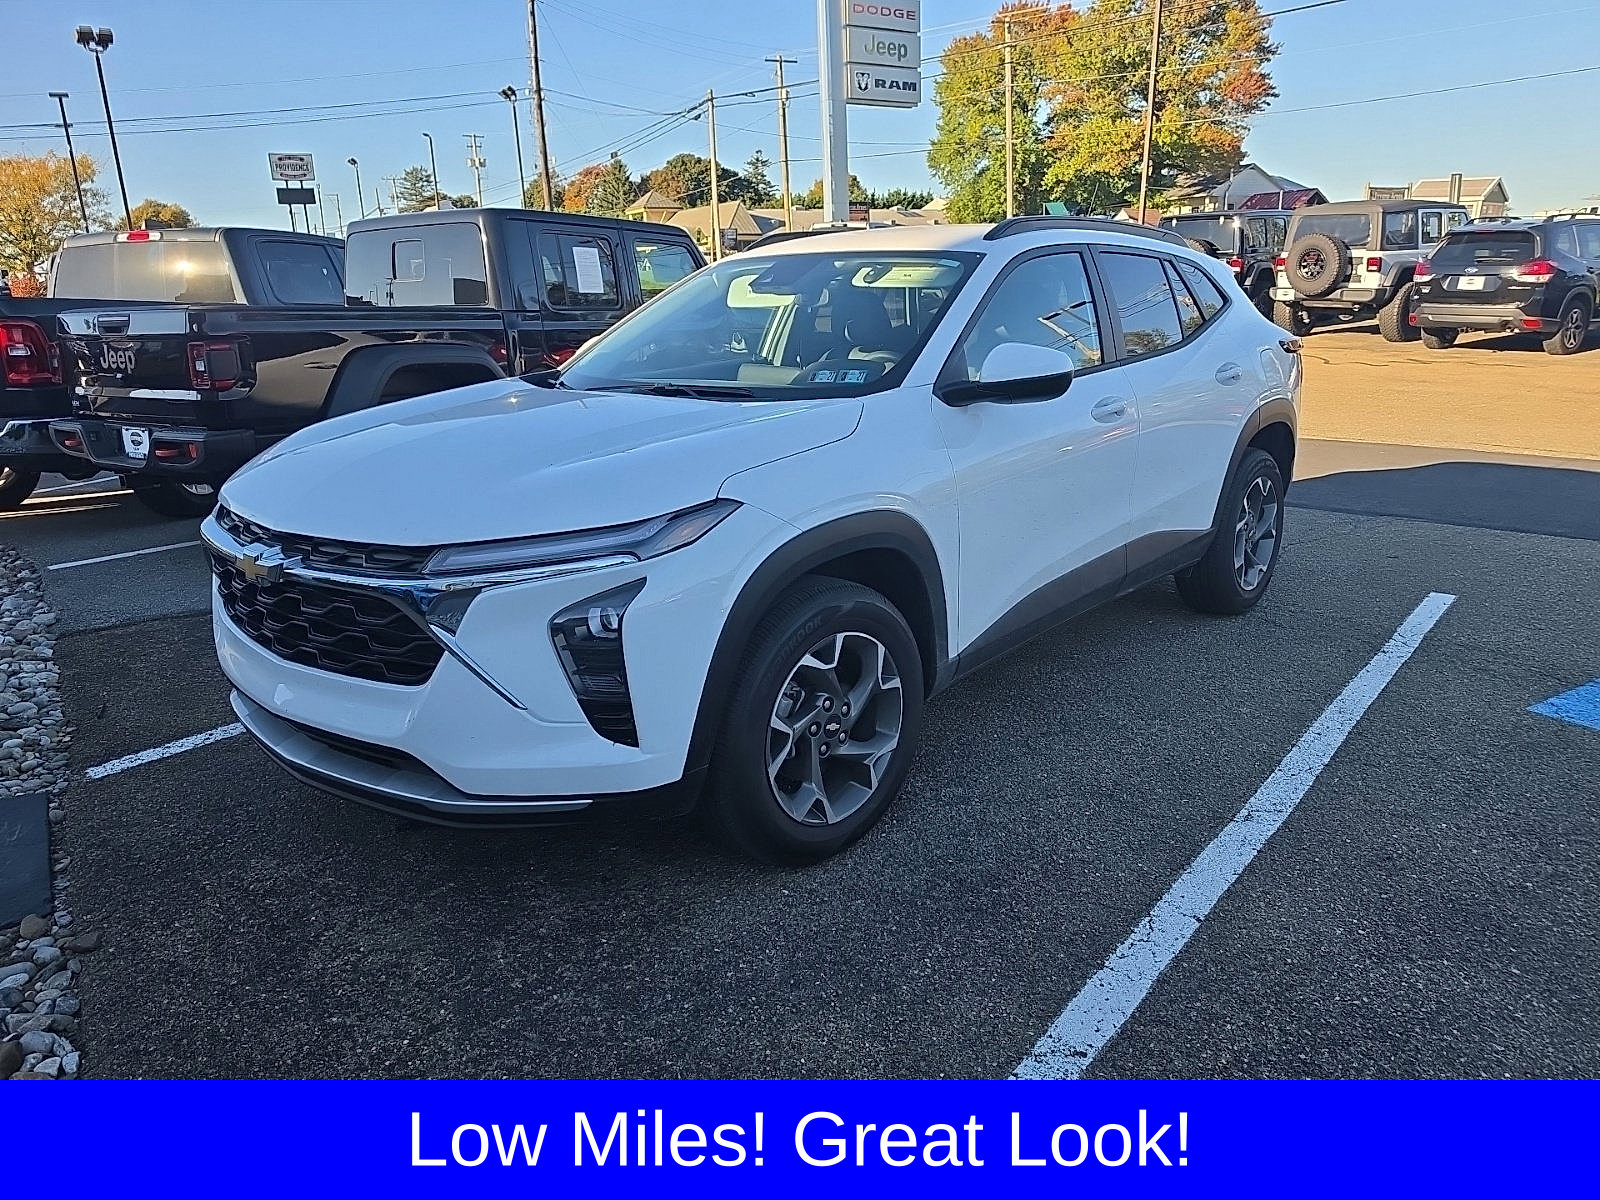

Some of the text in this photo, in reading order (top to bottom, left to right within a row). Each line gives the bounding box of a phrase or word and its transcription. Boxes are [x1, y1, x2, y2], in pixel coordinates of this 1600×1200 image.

[853, 3, 916, 20] DODGE
[864, 34, 908, 62] Jeep
[874, 78, 917, 91] RAM
[100, 343, 136, 374] Jeep
